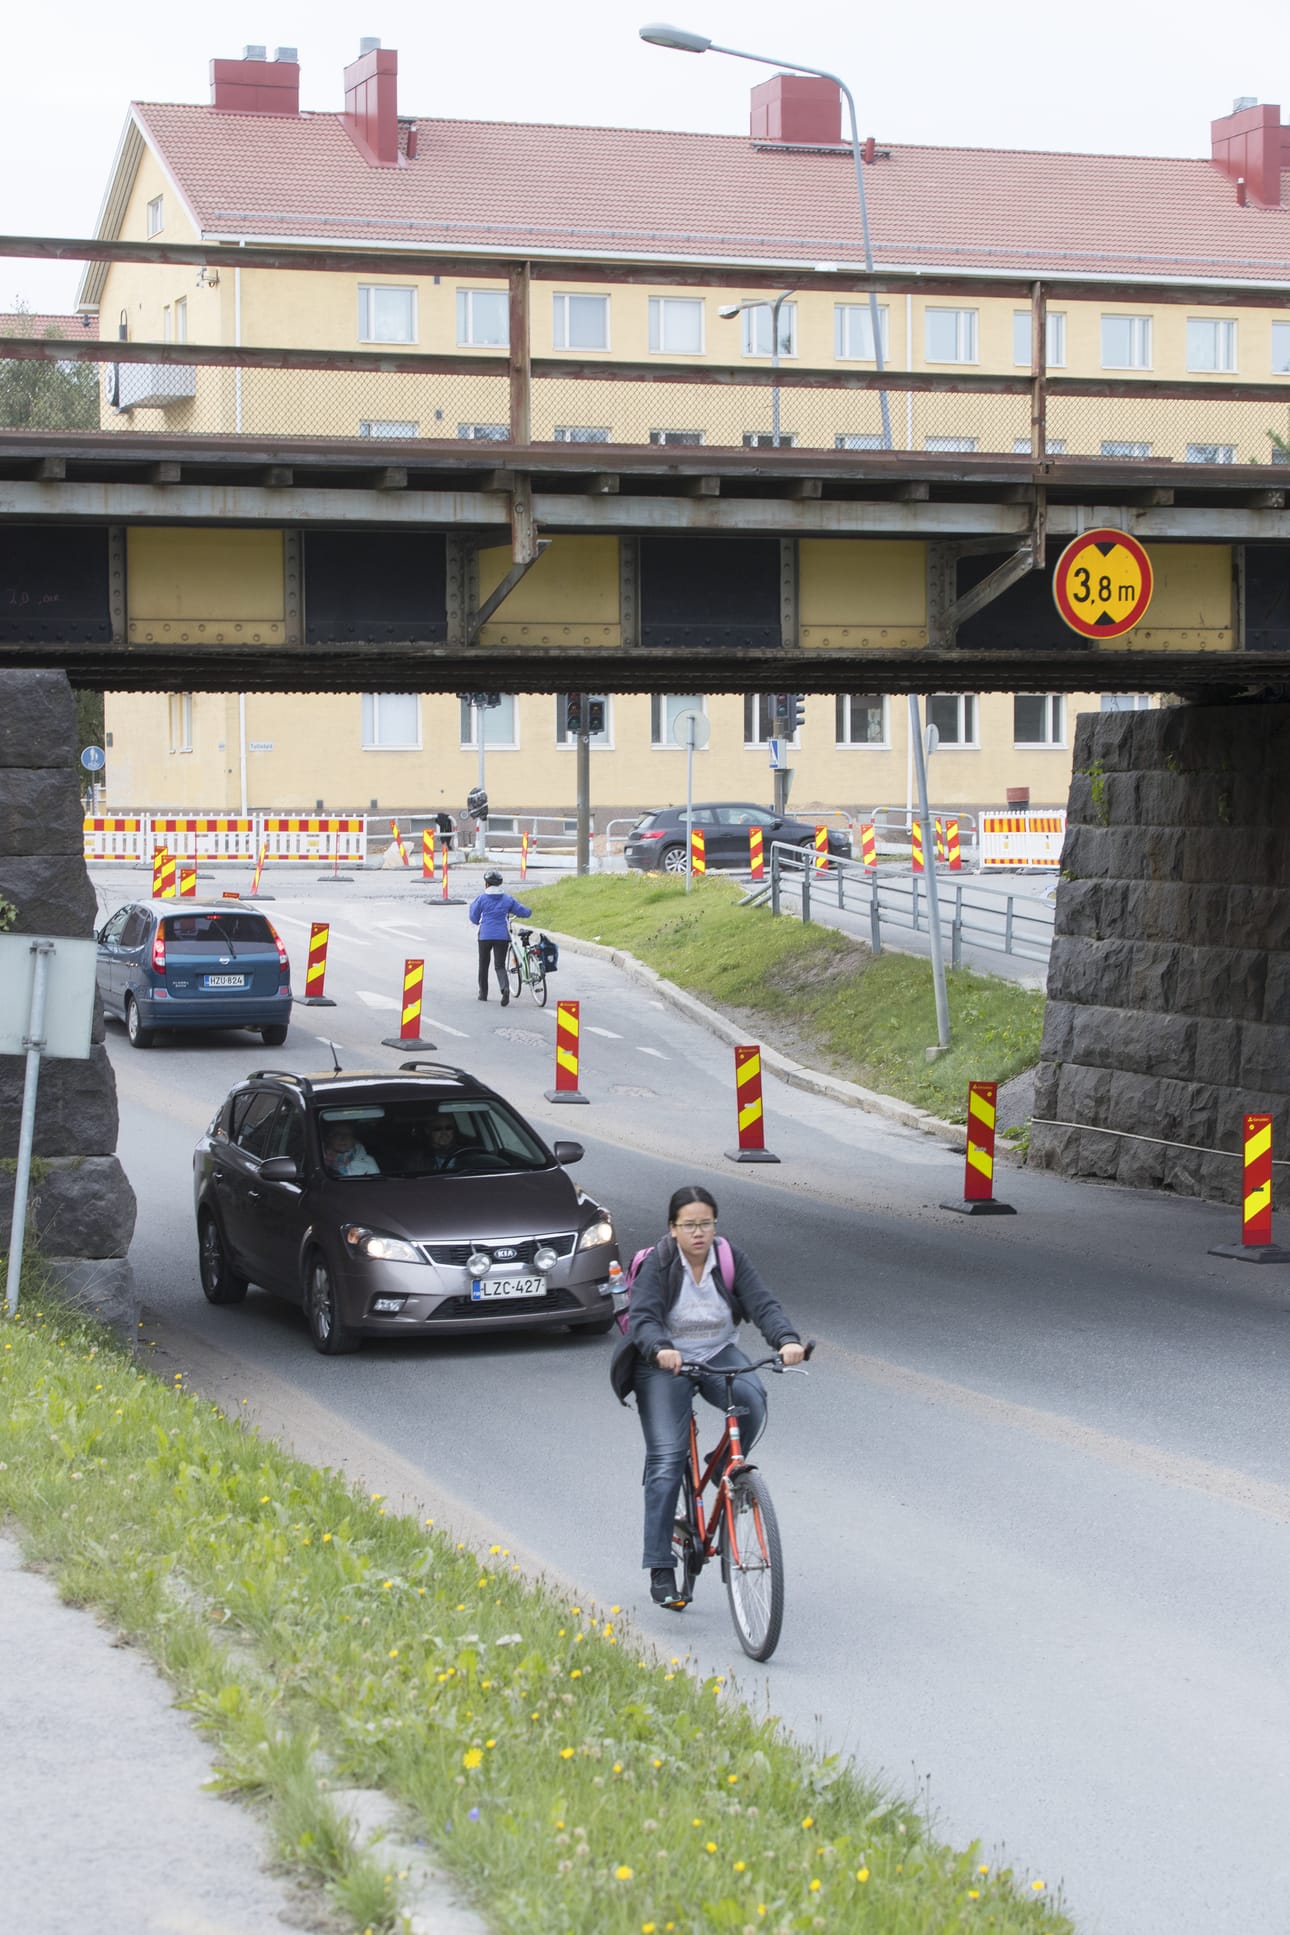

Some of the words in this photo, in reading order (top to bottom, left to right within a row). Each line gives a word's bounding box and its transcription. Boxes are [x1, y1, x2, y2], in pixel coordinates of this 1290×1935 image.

[1073, 567, 1111, 606] 3,8
[1118, 585, 1135, 602] m
[210, 976, 243, 985] HZU-824
[497, 1250, 514, 1258] KIA
[483, 1279, 542, 1297] LZC-427
